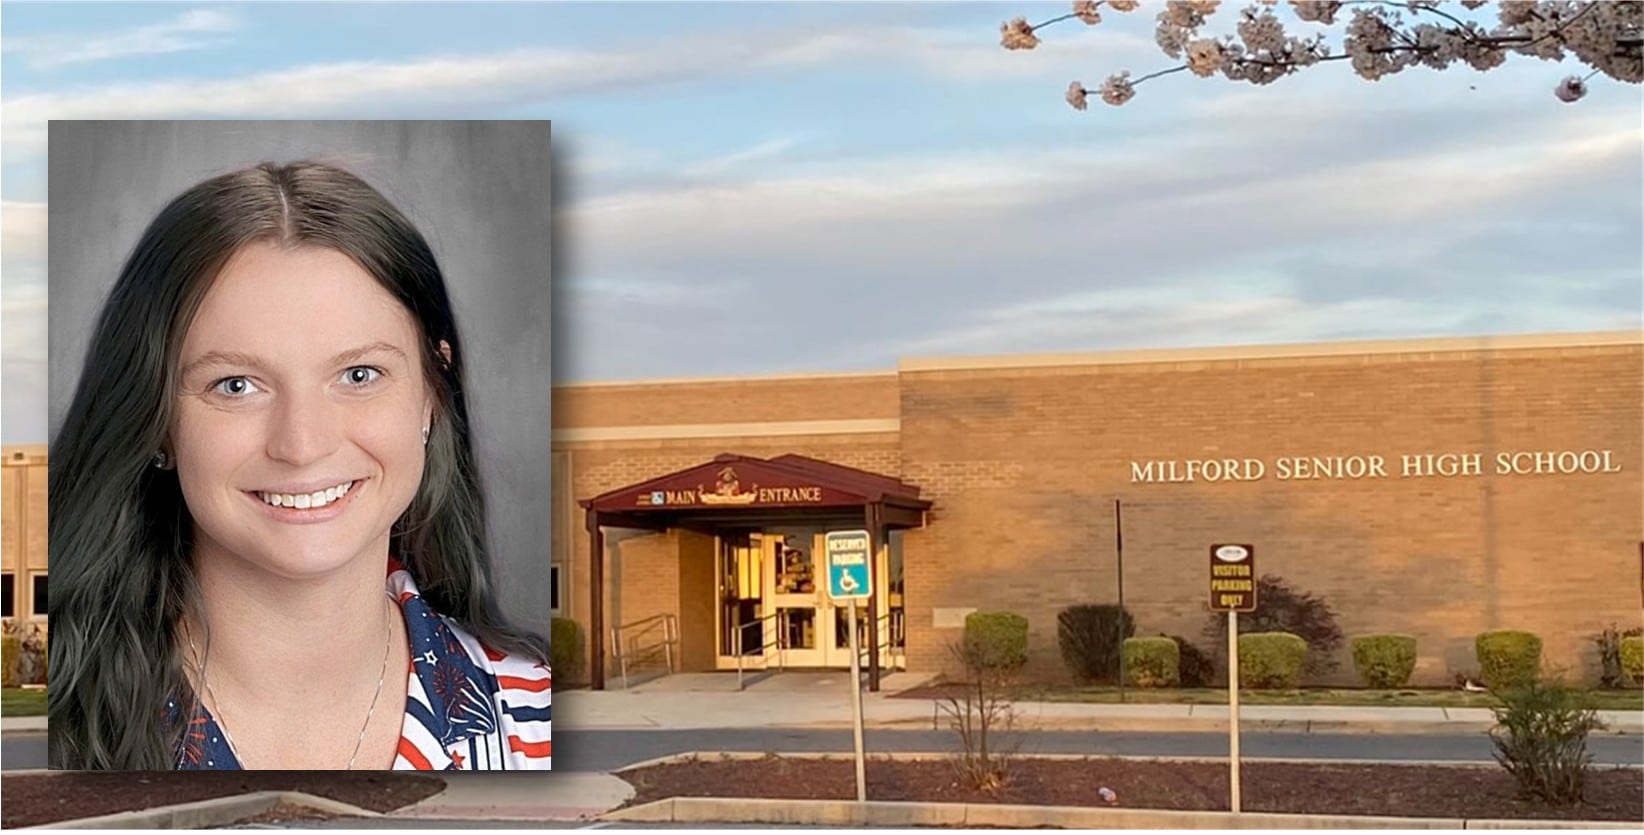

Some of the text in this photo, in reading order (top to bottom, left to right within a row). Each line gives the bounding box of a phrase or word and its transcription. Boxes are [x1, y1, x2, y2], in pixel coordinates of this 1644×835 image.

[1130, 450, 1622, 483] MILFORD SENIOR HIGH SCHOOL
[665, 490, 696, 505] MAIN
[759, 487, 822, 502] ENTRANCE
[829, 538, 866, 551] RESERVED
[832, 553, 865, 566] PARKING
[1213, 564, 1250, 577] VISITOR
[1211, 579, 1252, 592] PARKING
[1220, 594, 1243, 606] ONLY
